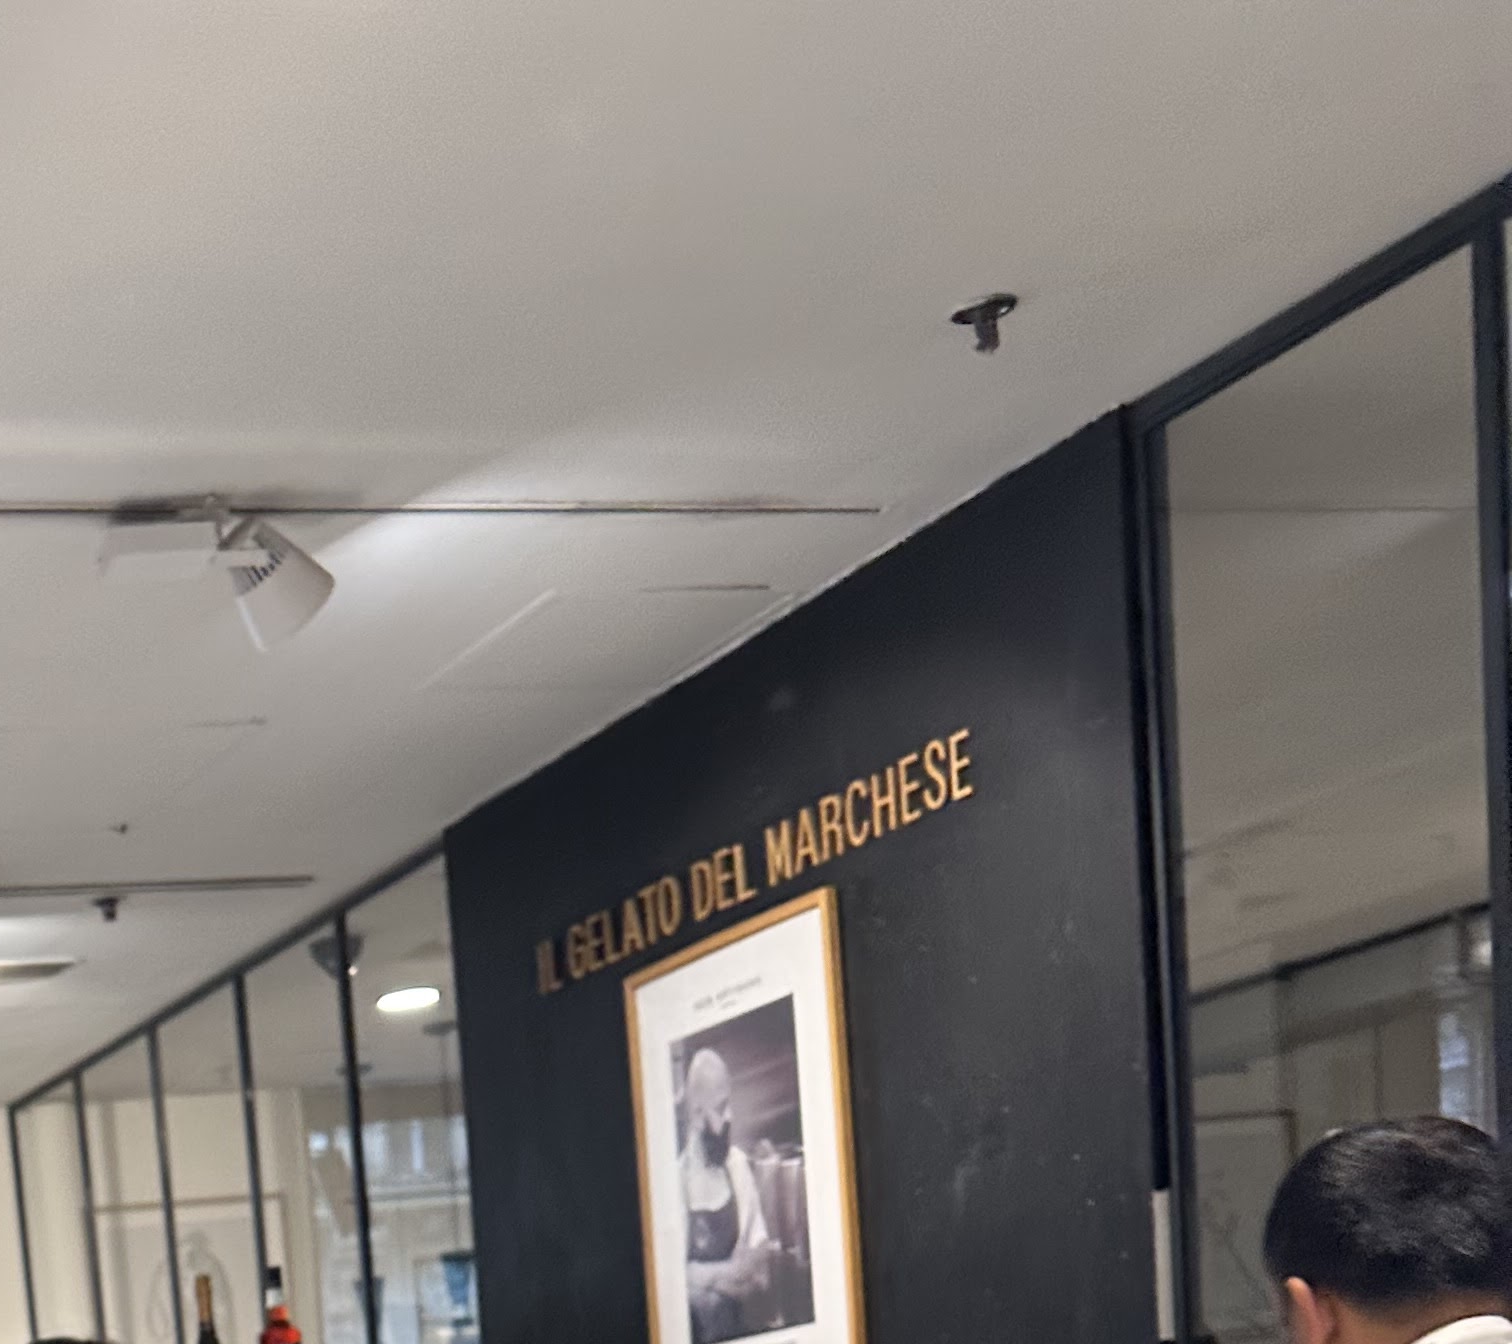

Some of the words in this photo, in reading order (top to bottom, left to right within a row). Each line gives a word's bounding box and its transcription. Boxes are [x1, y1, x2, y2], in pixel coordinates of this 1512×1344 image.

[535, 936, 564, 995] IL
[567, 875, 683, 980] GELATO
[690, 842, 758, 924] DEL
[763, 727, 975, 887] MARCHESE
